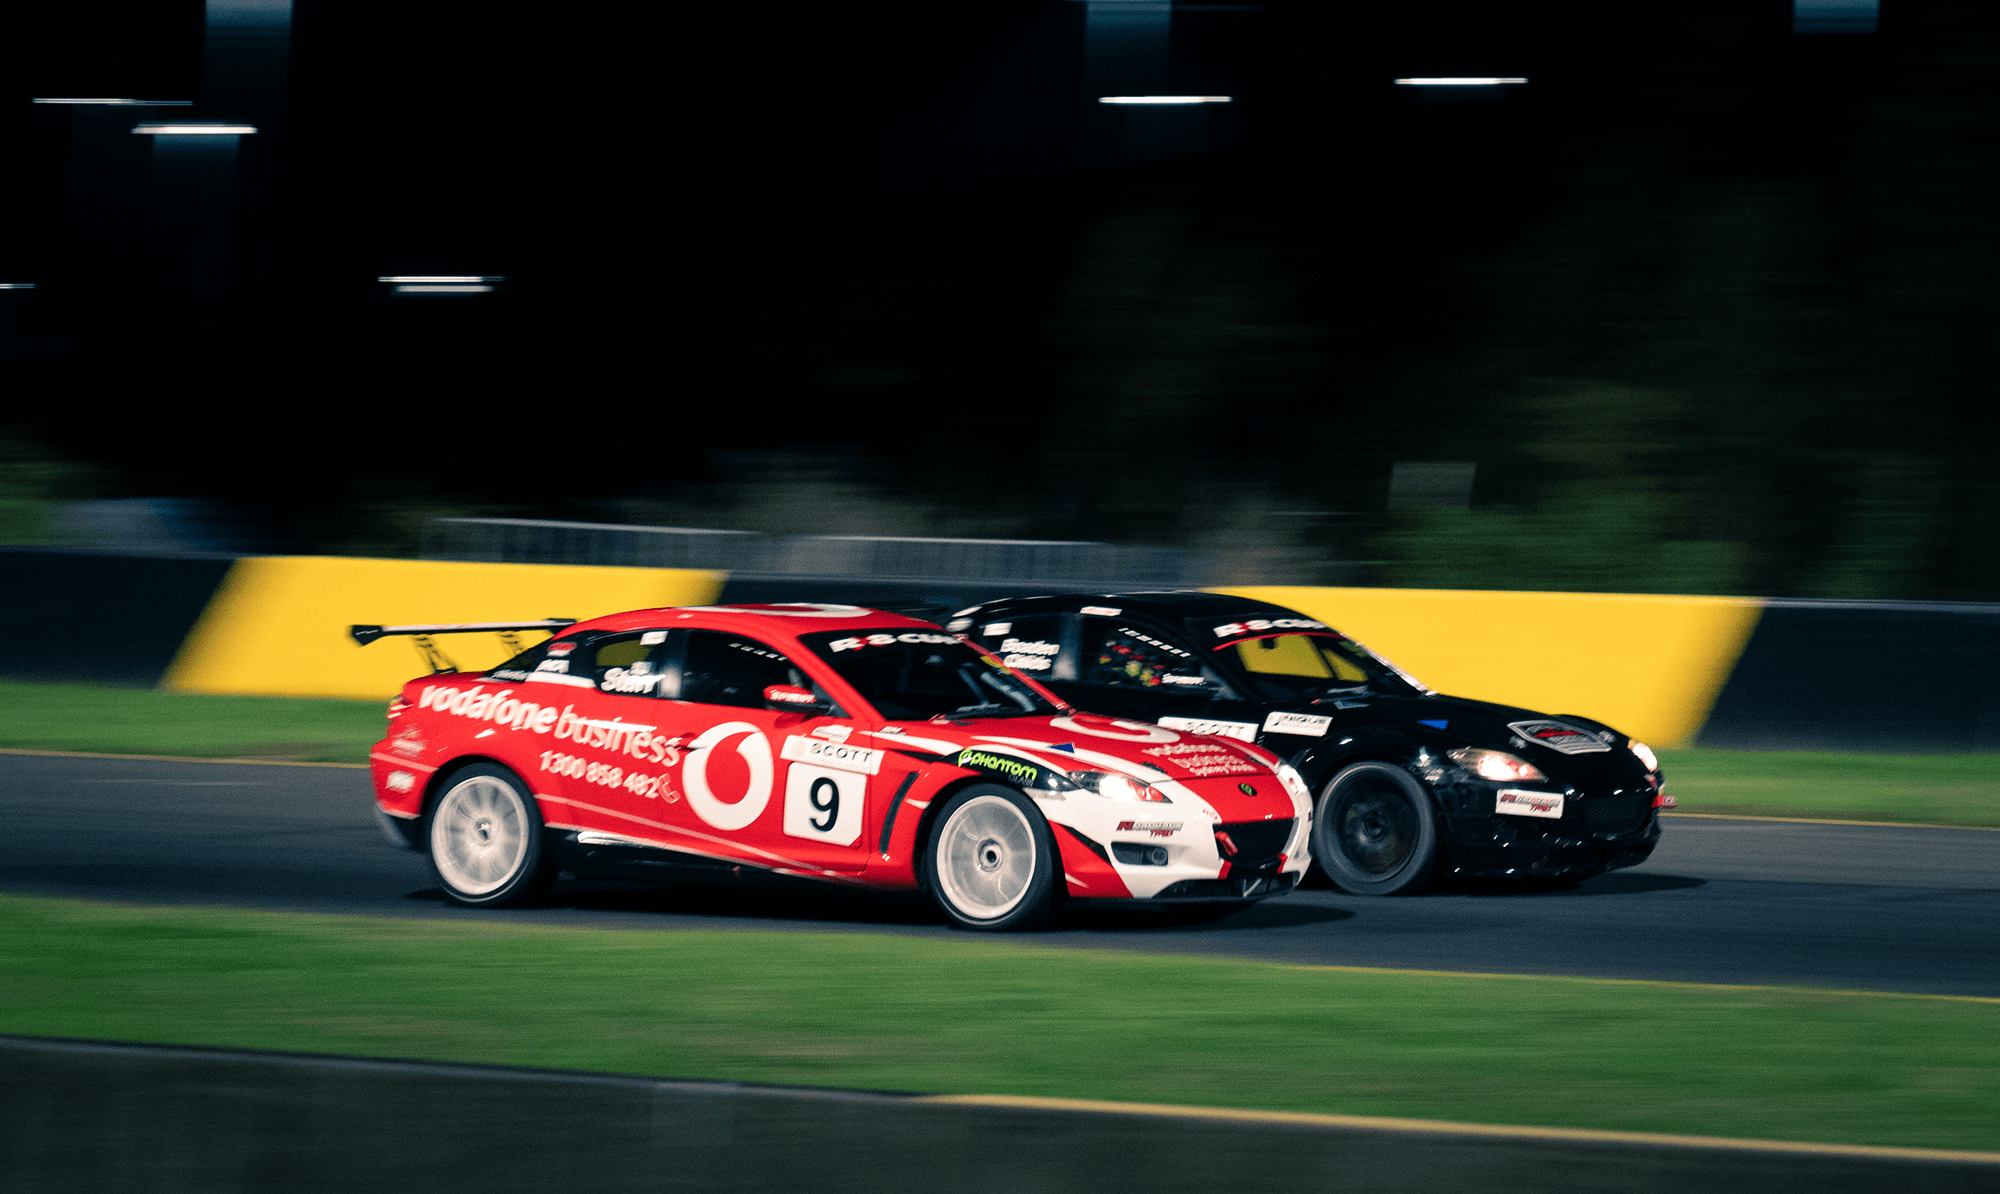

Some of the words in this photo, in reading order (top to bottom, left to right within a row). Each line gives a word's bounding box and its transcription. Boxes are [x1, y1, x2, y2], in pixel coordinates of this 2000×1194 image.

[418, 685, 558, 734] vodafone
[554, 704, 680, 767] business
[540, 750, 587, 779] 1300
[585, 761, 623, 789] 858
[622, 771, 660, 799] 482
[811, 742, 873, 763] SCOTT
[809, 777, 840, 832] 9
